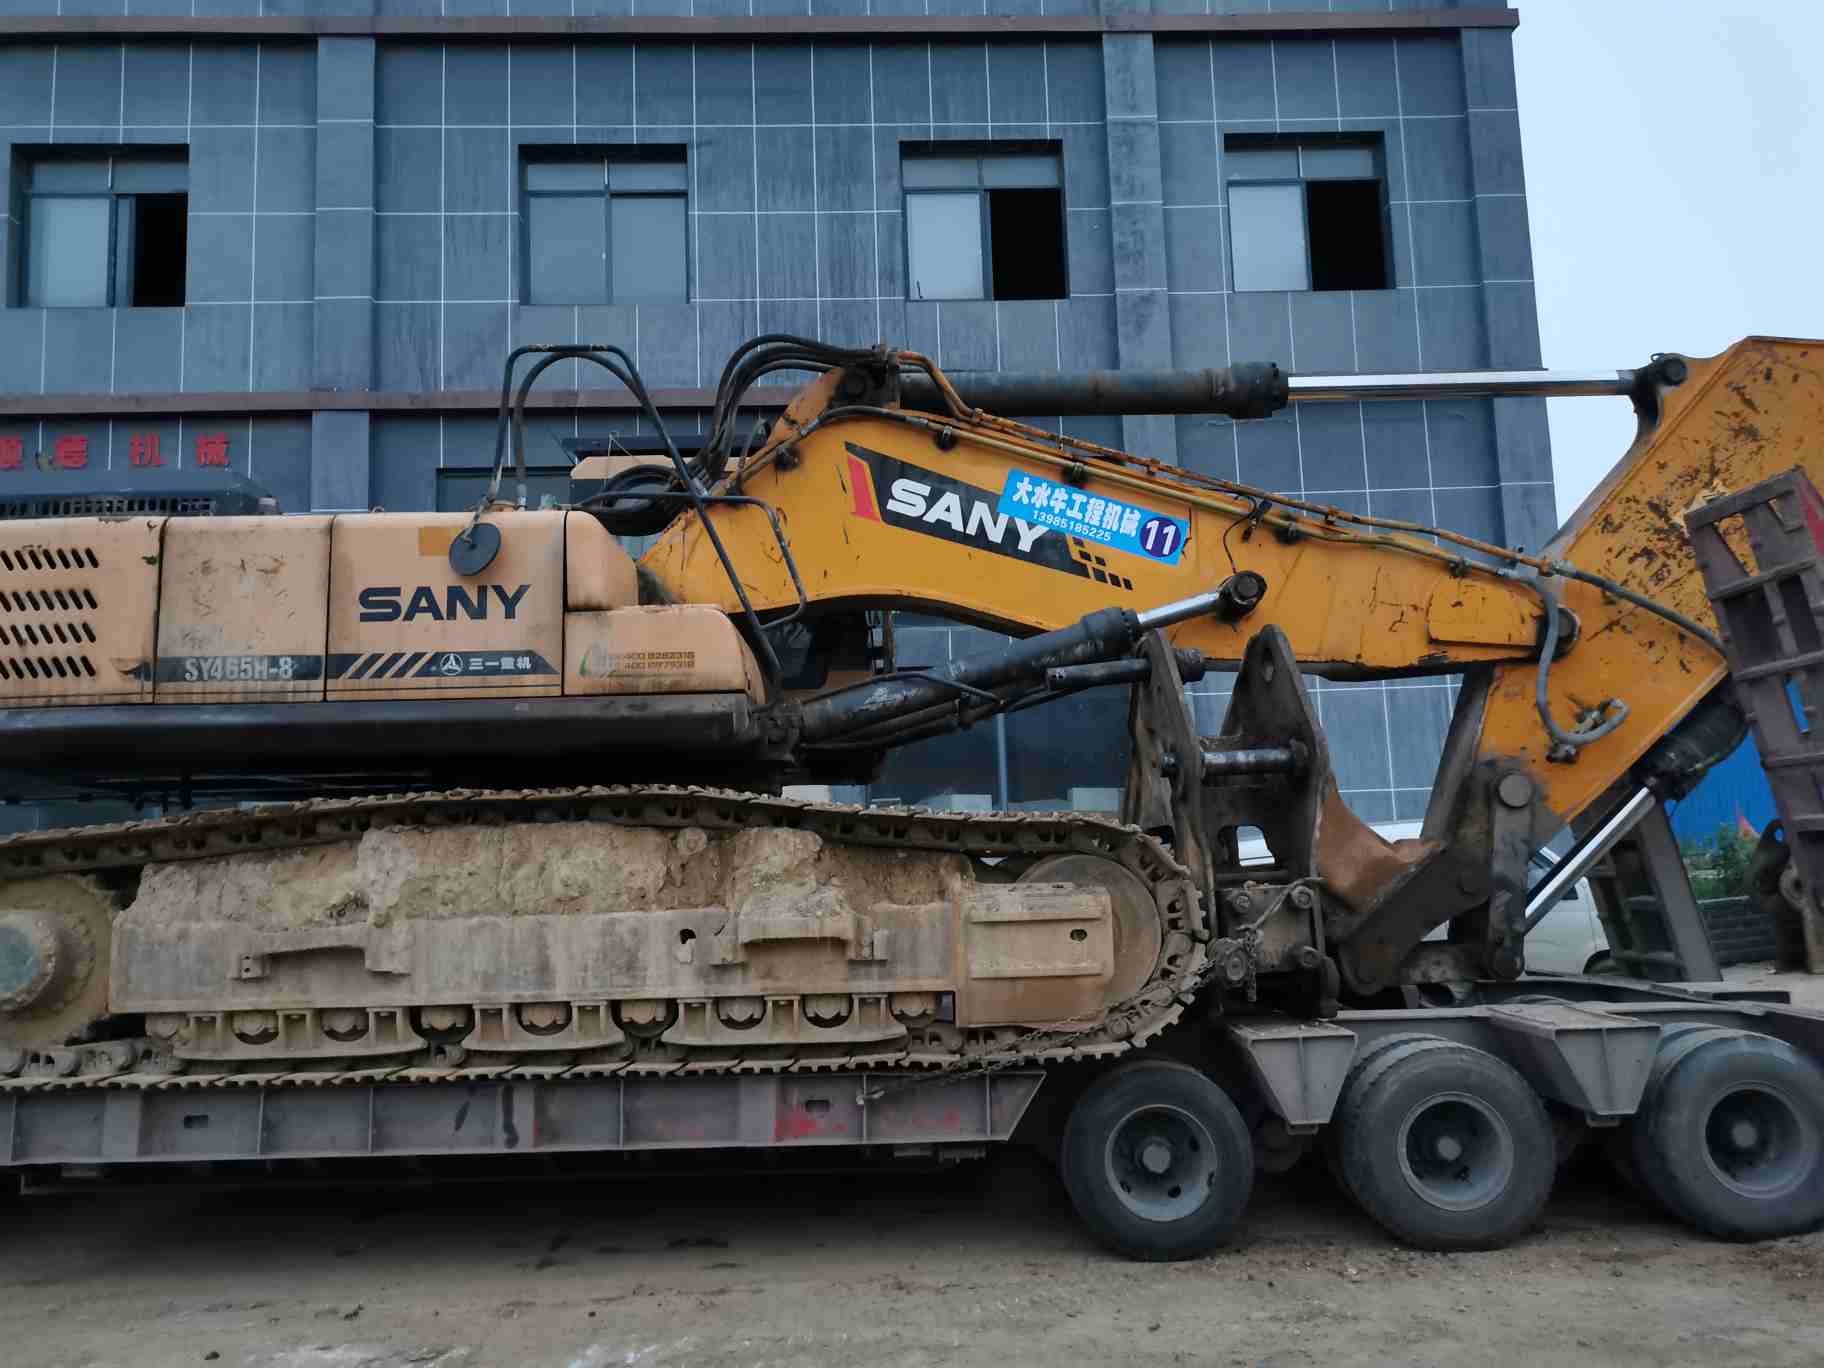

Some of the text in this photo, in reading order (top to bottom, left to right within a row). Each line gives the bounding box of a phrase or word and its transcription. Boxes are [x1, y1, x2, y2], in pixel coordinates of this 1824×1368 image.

[886, 478, 1051, 553] SANY
[1012, 477, 1142, 537] 大水牛工程机械
[1145, 519, 1177, 556] 11
[358, 584, 532, 622] SANY
[184, 656, 294, 681] SY465H-8
